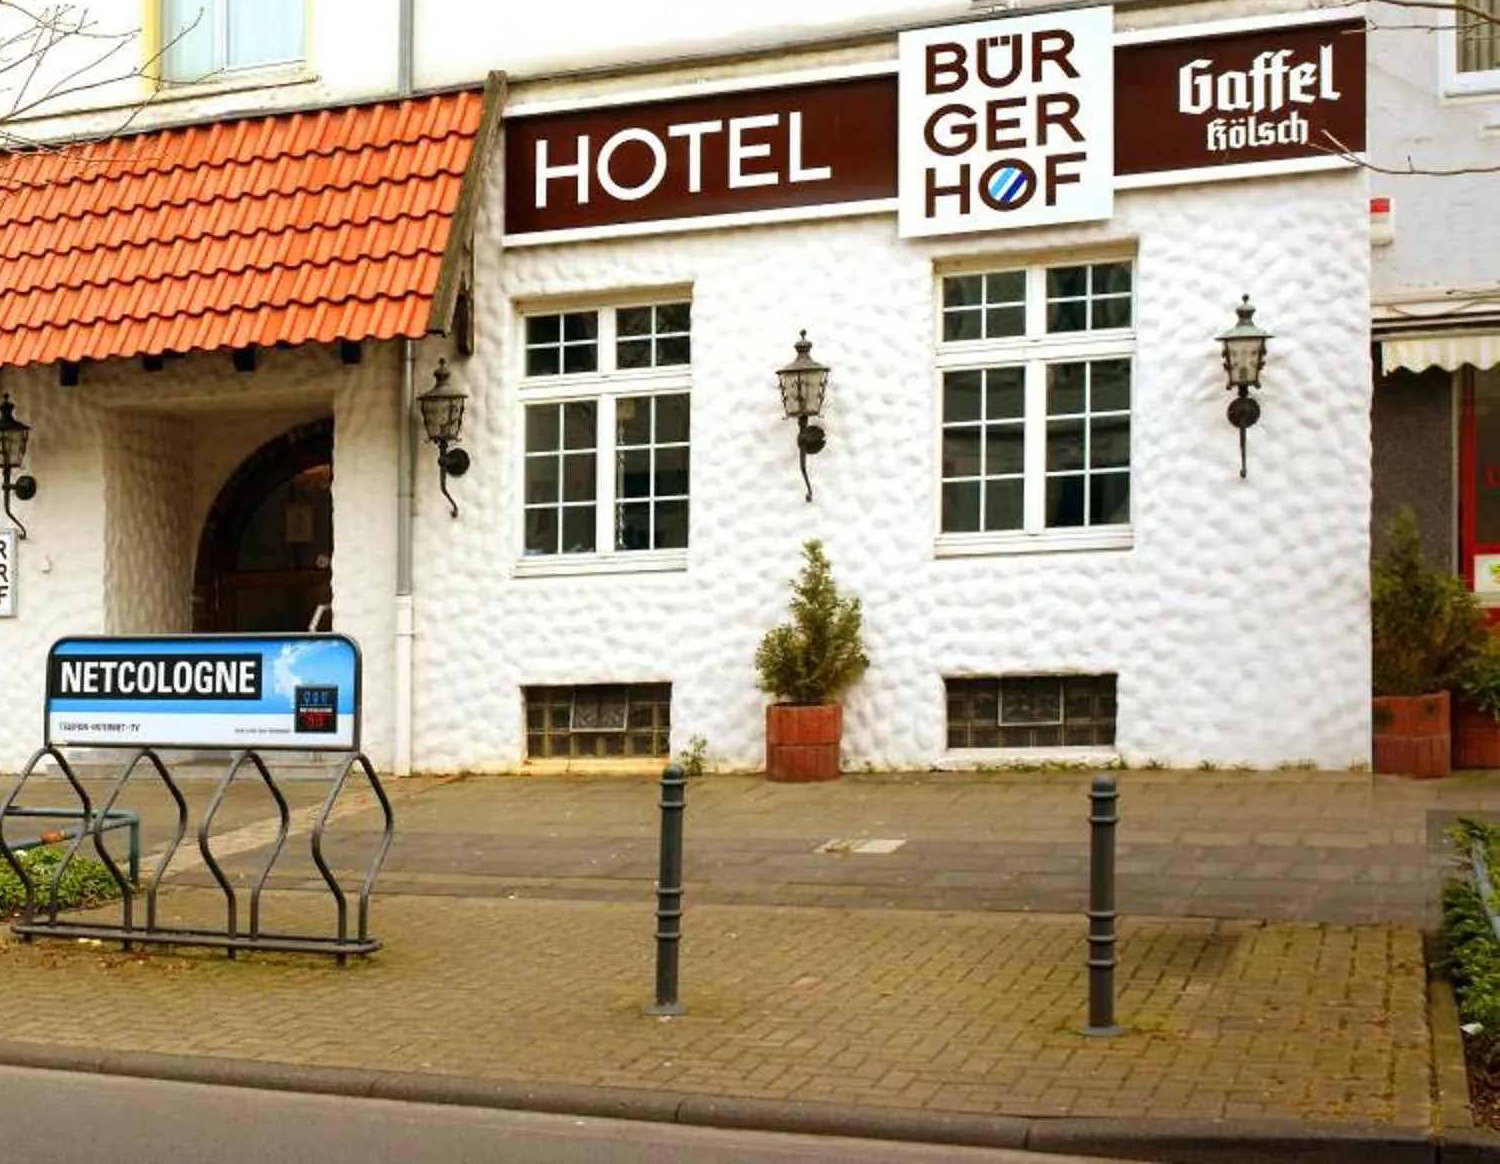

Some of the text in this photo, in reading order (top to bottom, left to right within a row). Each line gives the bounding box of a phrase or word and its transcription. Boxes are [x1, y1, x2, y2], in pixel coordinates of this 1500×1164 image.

[925, 29, 1081, 95] BÜR
[1179, 43, 1342, 115] Gaffel
[923, 92, 1086, 156] GER
[1207, 109, 1309, 151] Kölsch
[535, 111, 832, 209] HOTEL
[925, 151, 1087, 218] HOF
[60, 660, 256, 694] NETCOLOGNE
